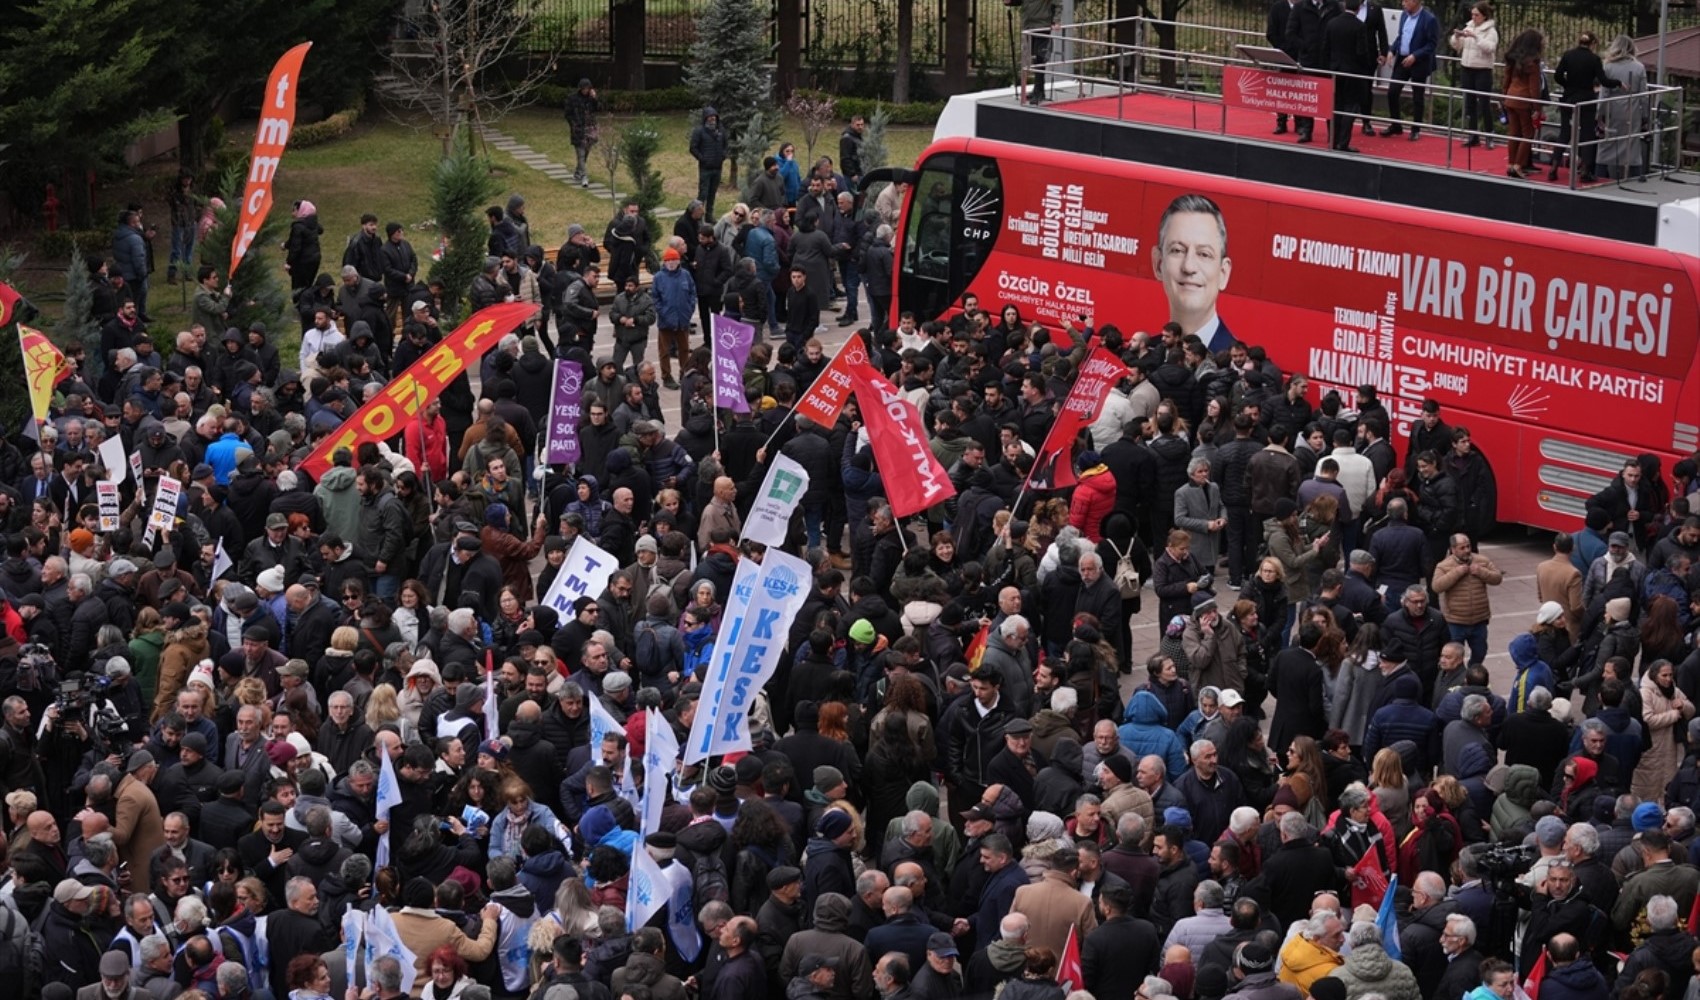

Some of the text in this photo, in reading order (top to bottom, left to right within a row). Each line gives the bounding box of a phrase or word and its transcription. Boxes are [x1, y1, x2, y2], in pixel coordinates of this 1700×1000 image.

[1266, 75, 1318, 90] CUMHURİYET
[1241, 95, 1275, 107] Türkiye'nin
[1276, 100, 1297, 110] Birinci
[1265, 88, 1318, 103] HALK PARTİSİ
[1062, 184, 1084, 228] GELİR
[1008, 215, 1039, 235] İSTİHDAM
[1040, 184, 1064, 259] BÖLÜŞÜM
[963, 227, 991, 240] CHP
[1063, 227, 1092, 247] ÜRETİM
[1092, 232, 1139, 256] TASARRUF
[1062, 246, 1106, 268] MİLLİ GELİR
[1272, 234, 1296, 261] CHP
[1357, 248, 1401, 279] TAKIMI
[998, 271, 1095, 305] ÖZGÜR ÖZEL
[998, 291, 1094, 316] CUMHURİYET HALK PARTİSİ
[1036, 307, 1060, 319] GENEL
[1401, 252, 1675, 358] VAR BİR ÇARESİ
[1334, 307, 1377, 333] TEKNOLOJİ
[1333, 327, 1366, 355] GIDA
[1378, 314, 1395, 361] SANAYİ
[1308, 347, 1394, 394] KALKINMA
[1402, 335, 1664, 404] CUMHURİYET HALK PARTİSİ
[820, 384, 839, 402] SOL
[1433, 371, 1469, 397] EMEKÇİ
[554, 403, 581, 420] YEŞİL
[806, 394, 838, 416] PARTİ
[556, 423, 575, 435] SOL
[550, 437, 576, 451] PARTİ
[762, 576, 800, 596] KESK
[722, 608, 780, 742] KESK
